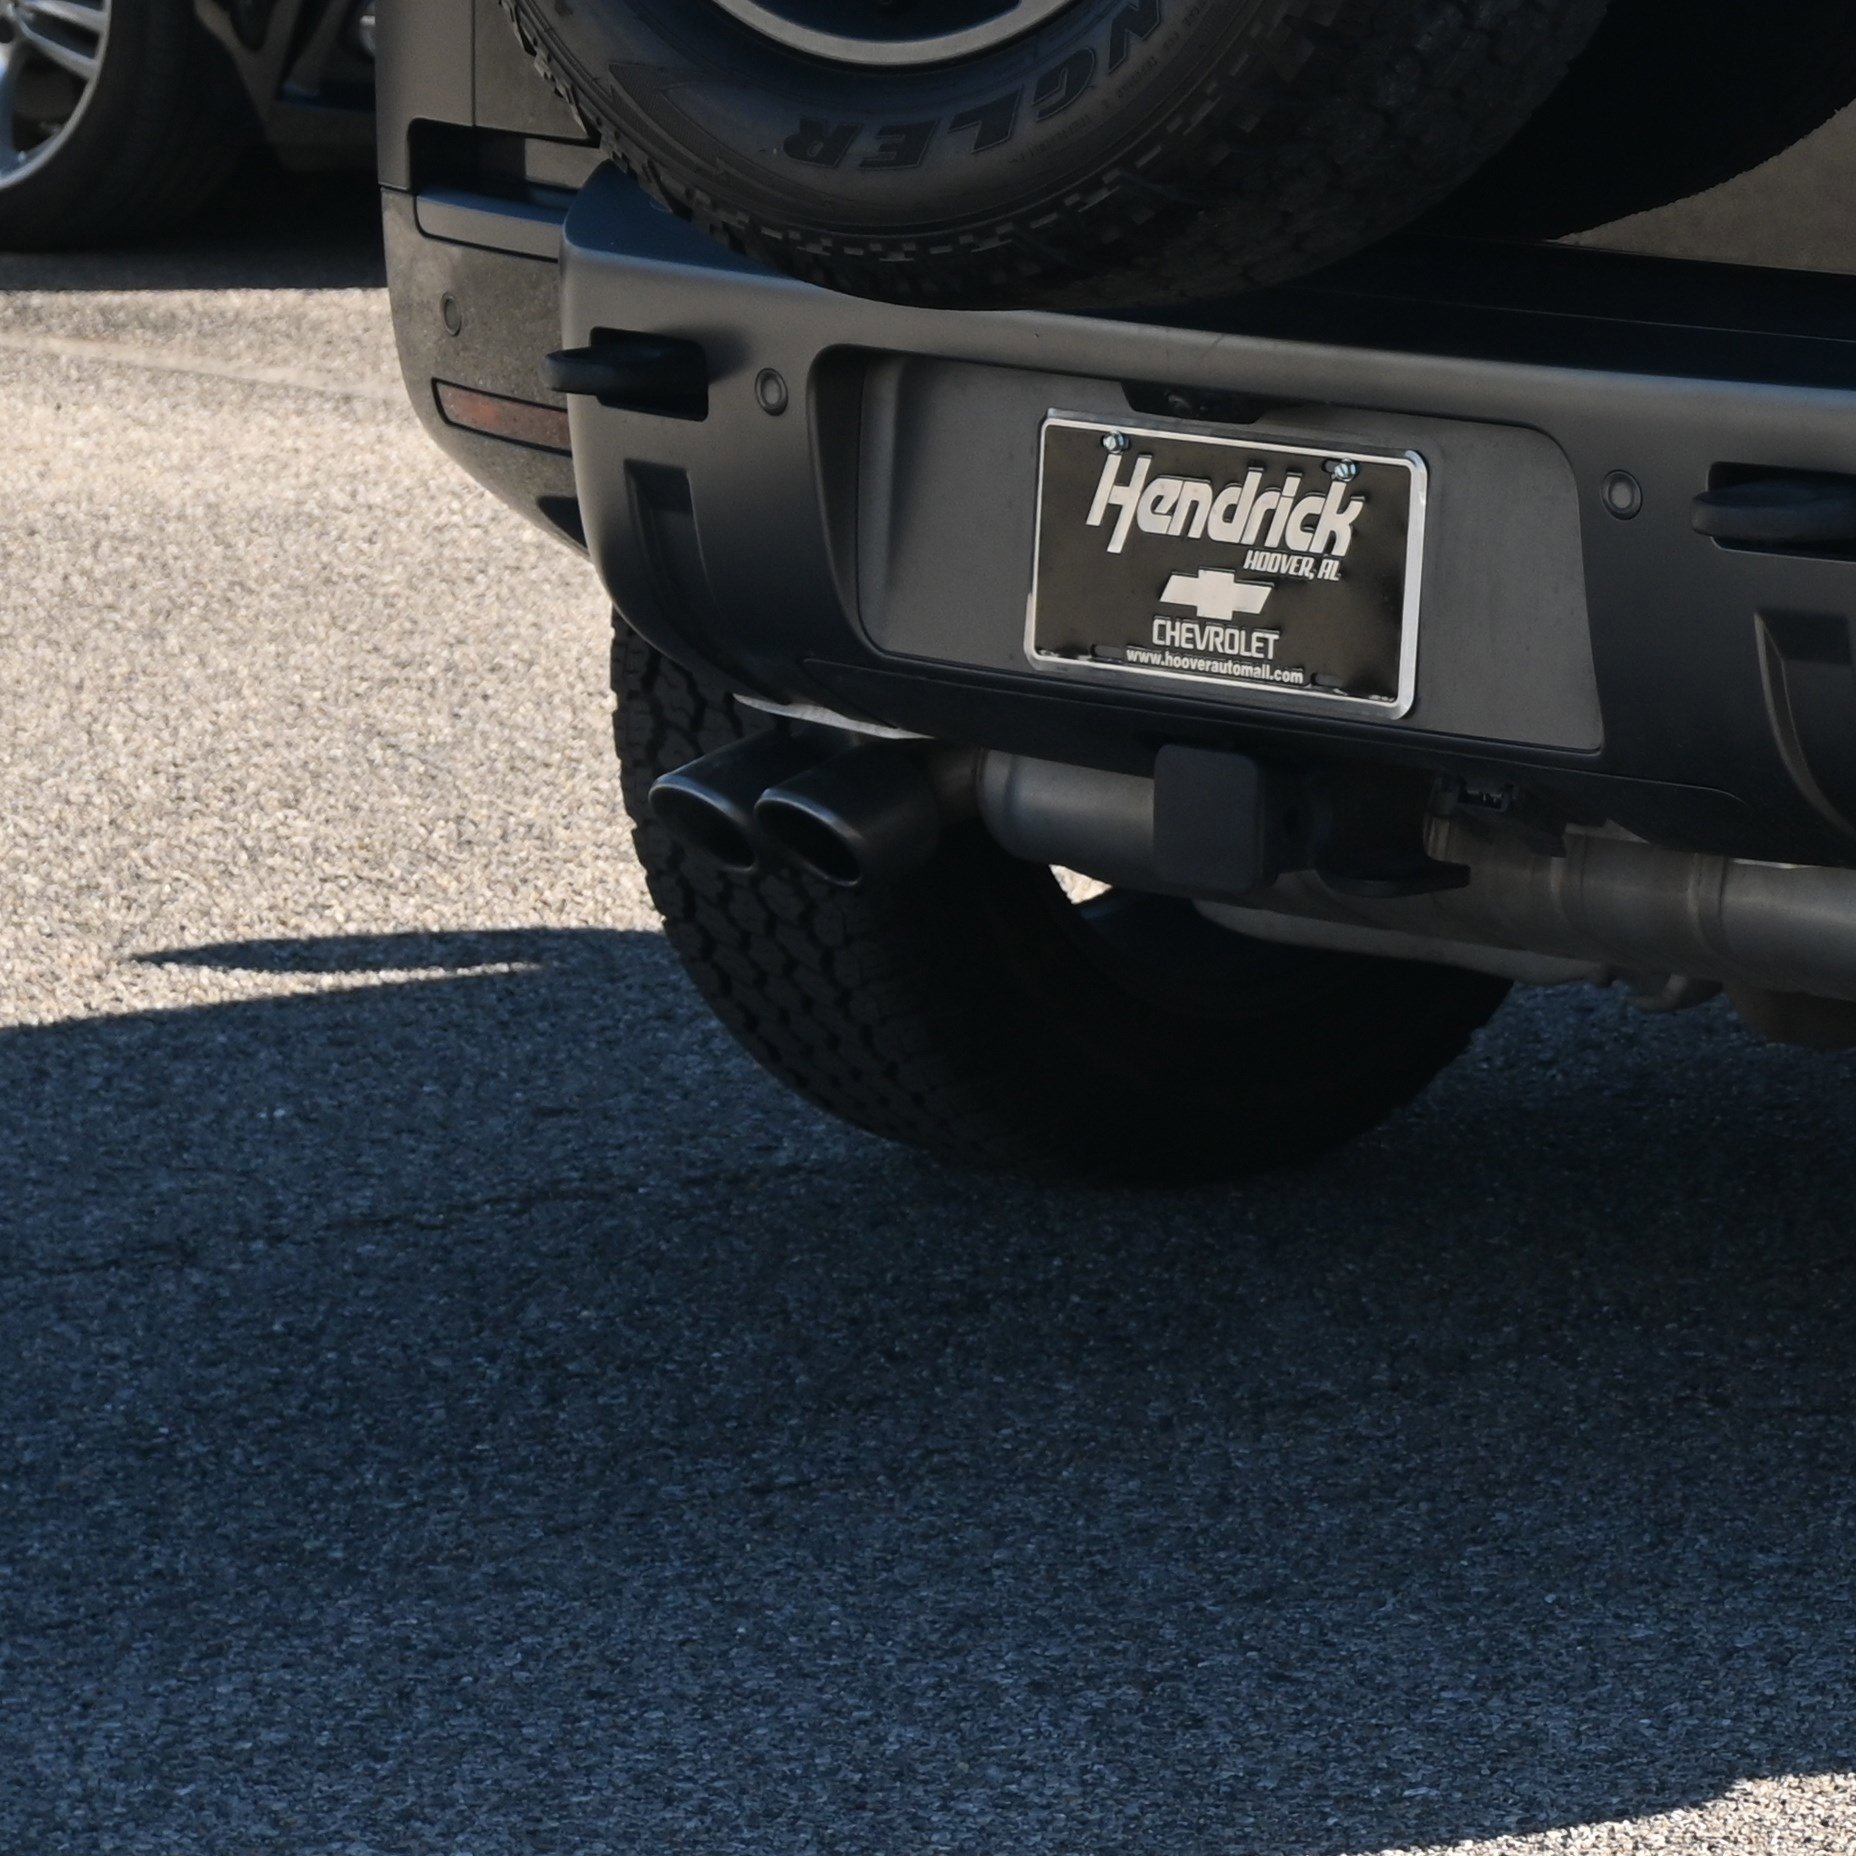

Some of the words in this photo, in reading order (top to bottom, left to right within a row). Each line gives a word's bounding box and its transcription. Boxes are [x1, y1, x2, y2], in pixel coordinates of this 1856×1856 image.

[1085, 453, 1366, 557] Hendrick
[1242, 549, 1316, 580] HOOVER,
[1151, 618, 1280, 661] CHEVROLET
[1125, 647, 1304, 685] www.hooverautomall.com
